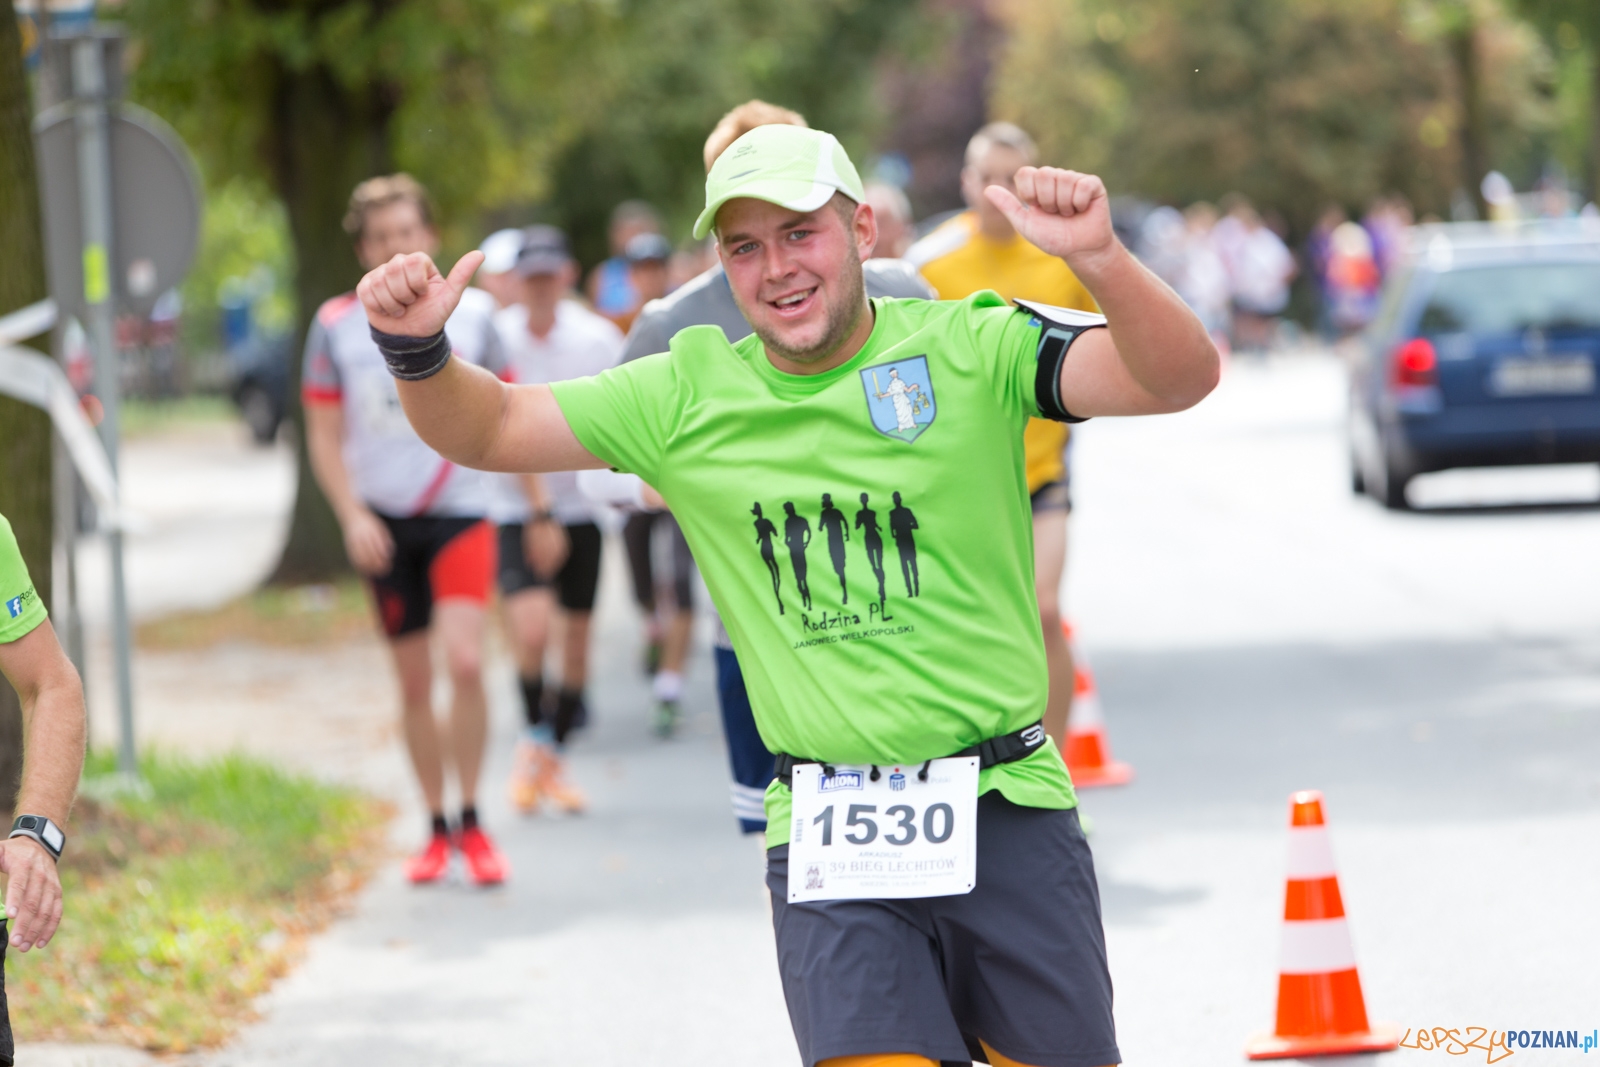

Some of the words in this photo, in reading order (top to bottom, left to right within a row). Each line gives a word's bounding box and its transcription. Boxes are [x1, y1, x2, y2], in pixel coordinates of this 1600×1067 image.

[801, 611, 861, 633] Rodzina
[841, 625, 914, 641] WIELKOPOLSKI
[823, 774, 859, 790] ALLOM
[812, 802, 954, 846] 1530
[829, 861, 846, 873] 39
[850, 860, 883, 872] BIEG
[888, 856, 957, 872] LECHITÓW
